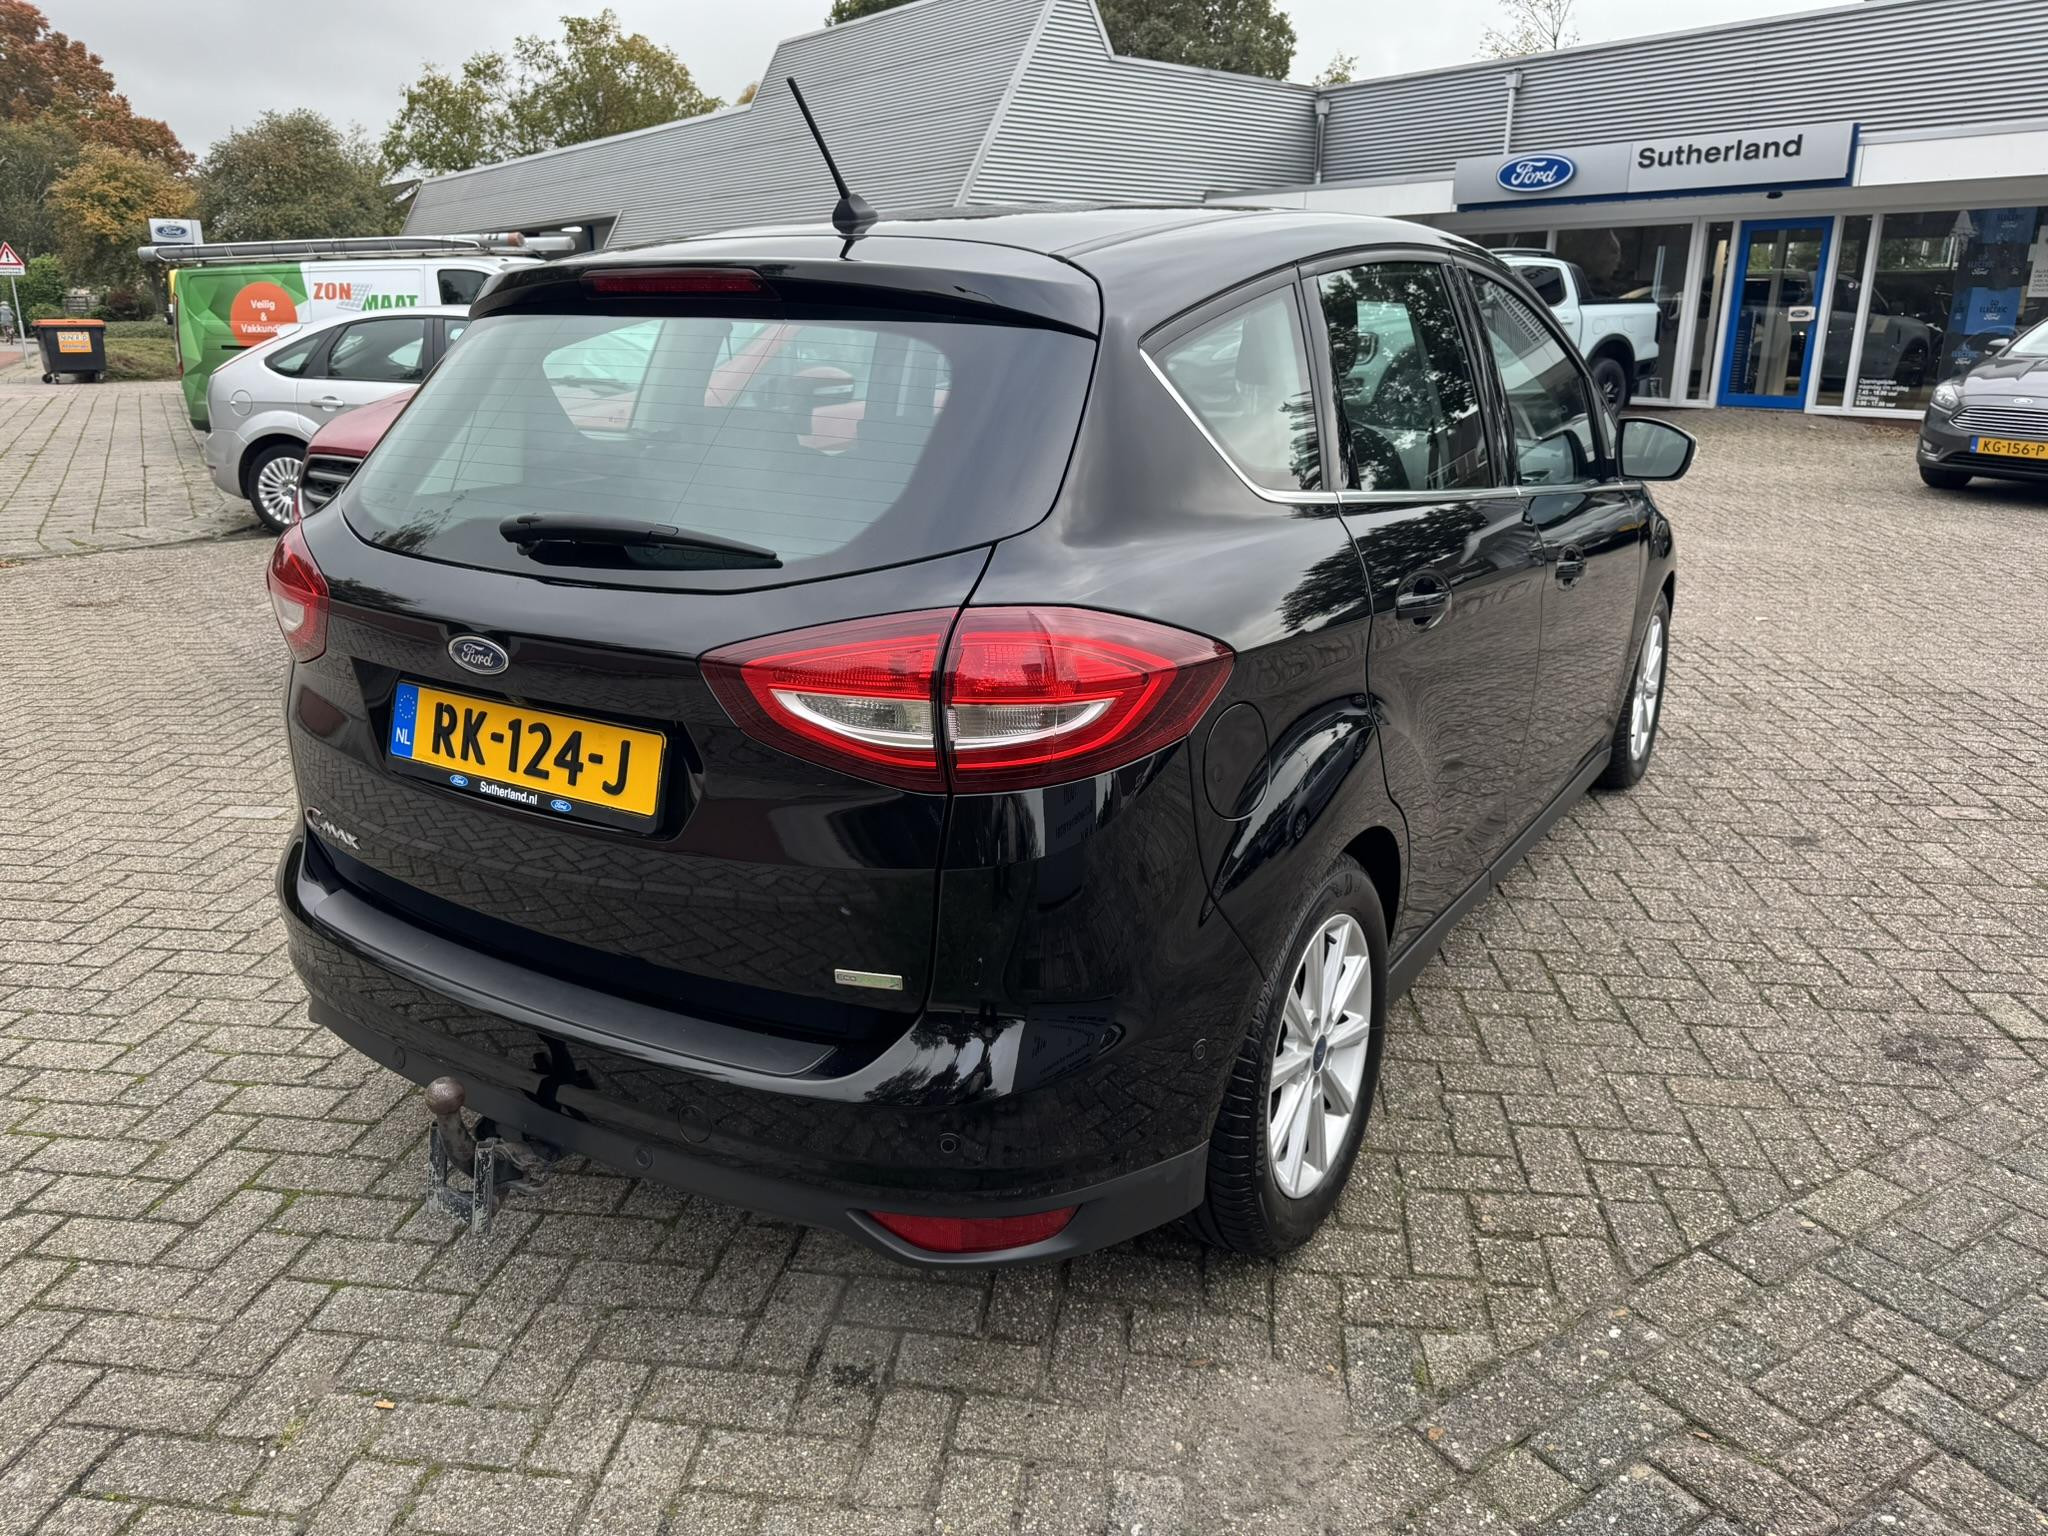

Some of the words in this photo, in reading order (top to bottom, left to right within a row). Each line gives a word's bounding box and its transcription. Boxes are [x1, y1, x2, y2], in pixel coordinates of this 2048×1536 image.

[1637, 133, 1804, 169] Sutherland
[1511, 160, 1557, 185] Ford
[313, 282, 352, 300] ZON
[250, 300, 276, 311] Veilig
[361, 294, 419, 311] MAAT
[260, 312, 267, 322] &
[1982, 440, 2046, 456] KG-156-P
[461, 643, 494, 668] Ford
[395, 727, 411, 745] NL
[431, 702, 631, 796] RK-124-J
[480, 781, 538, 805] Sutherland.nl
